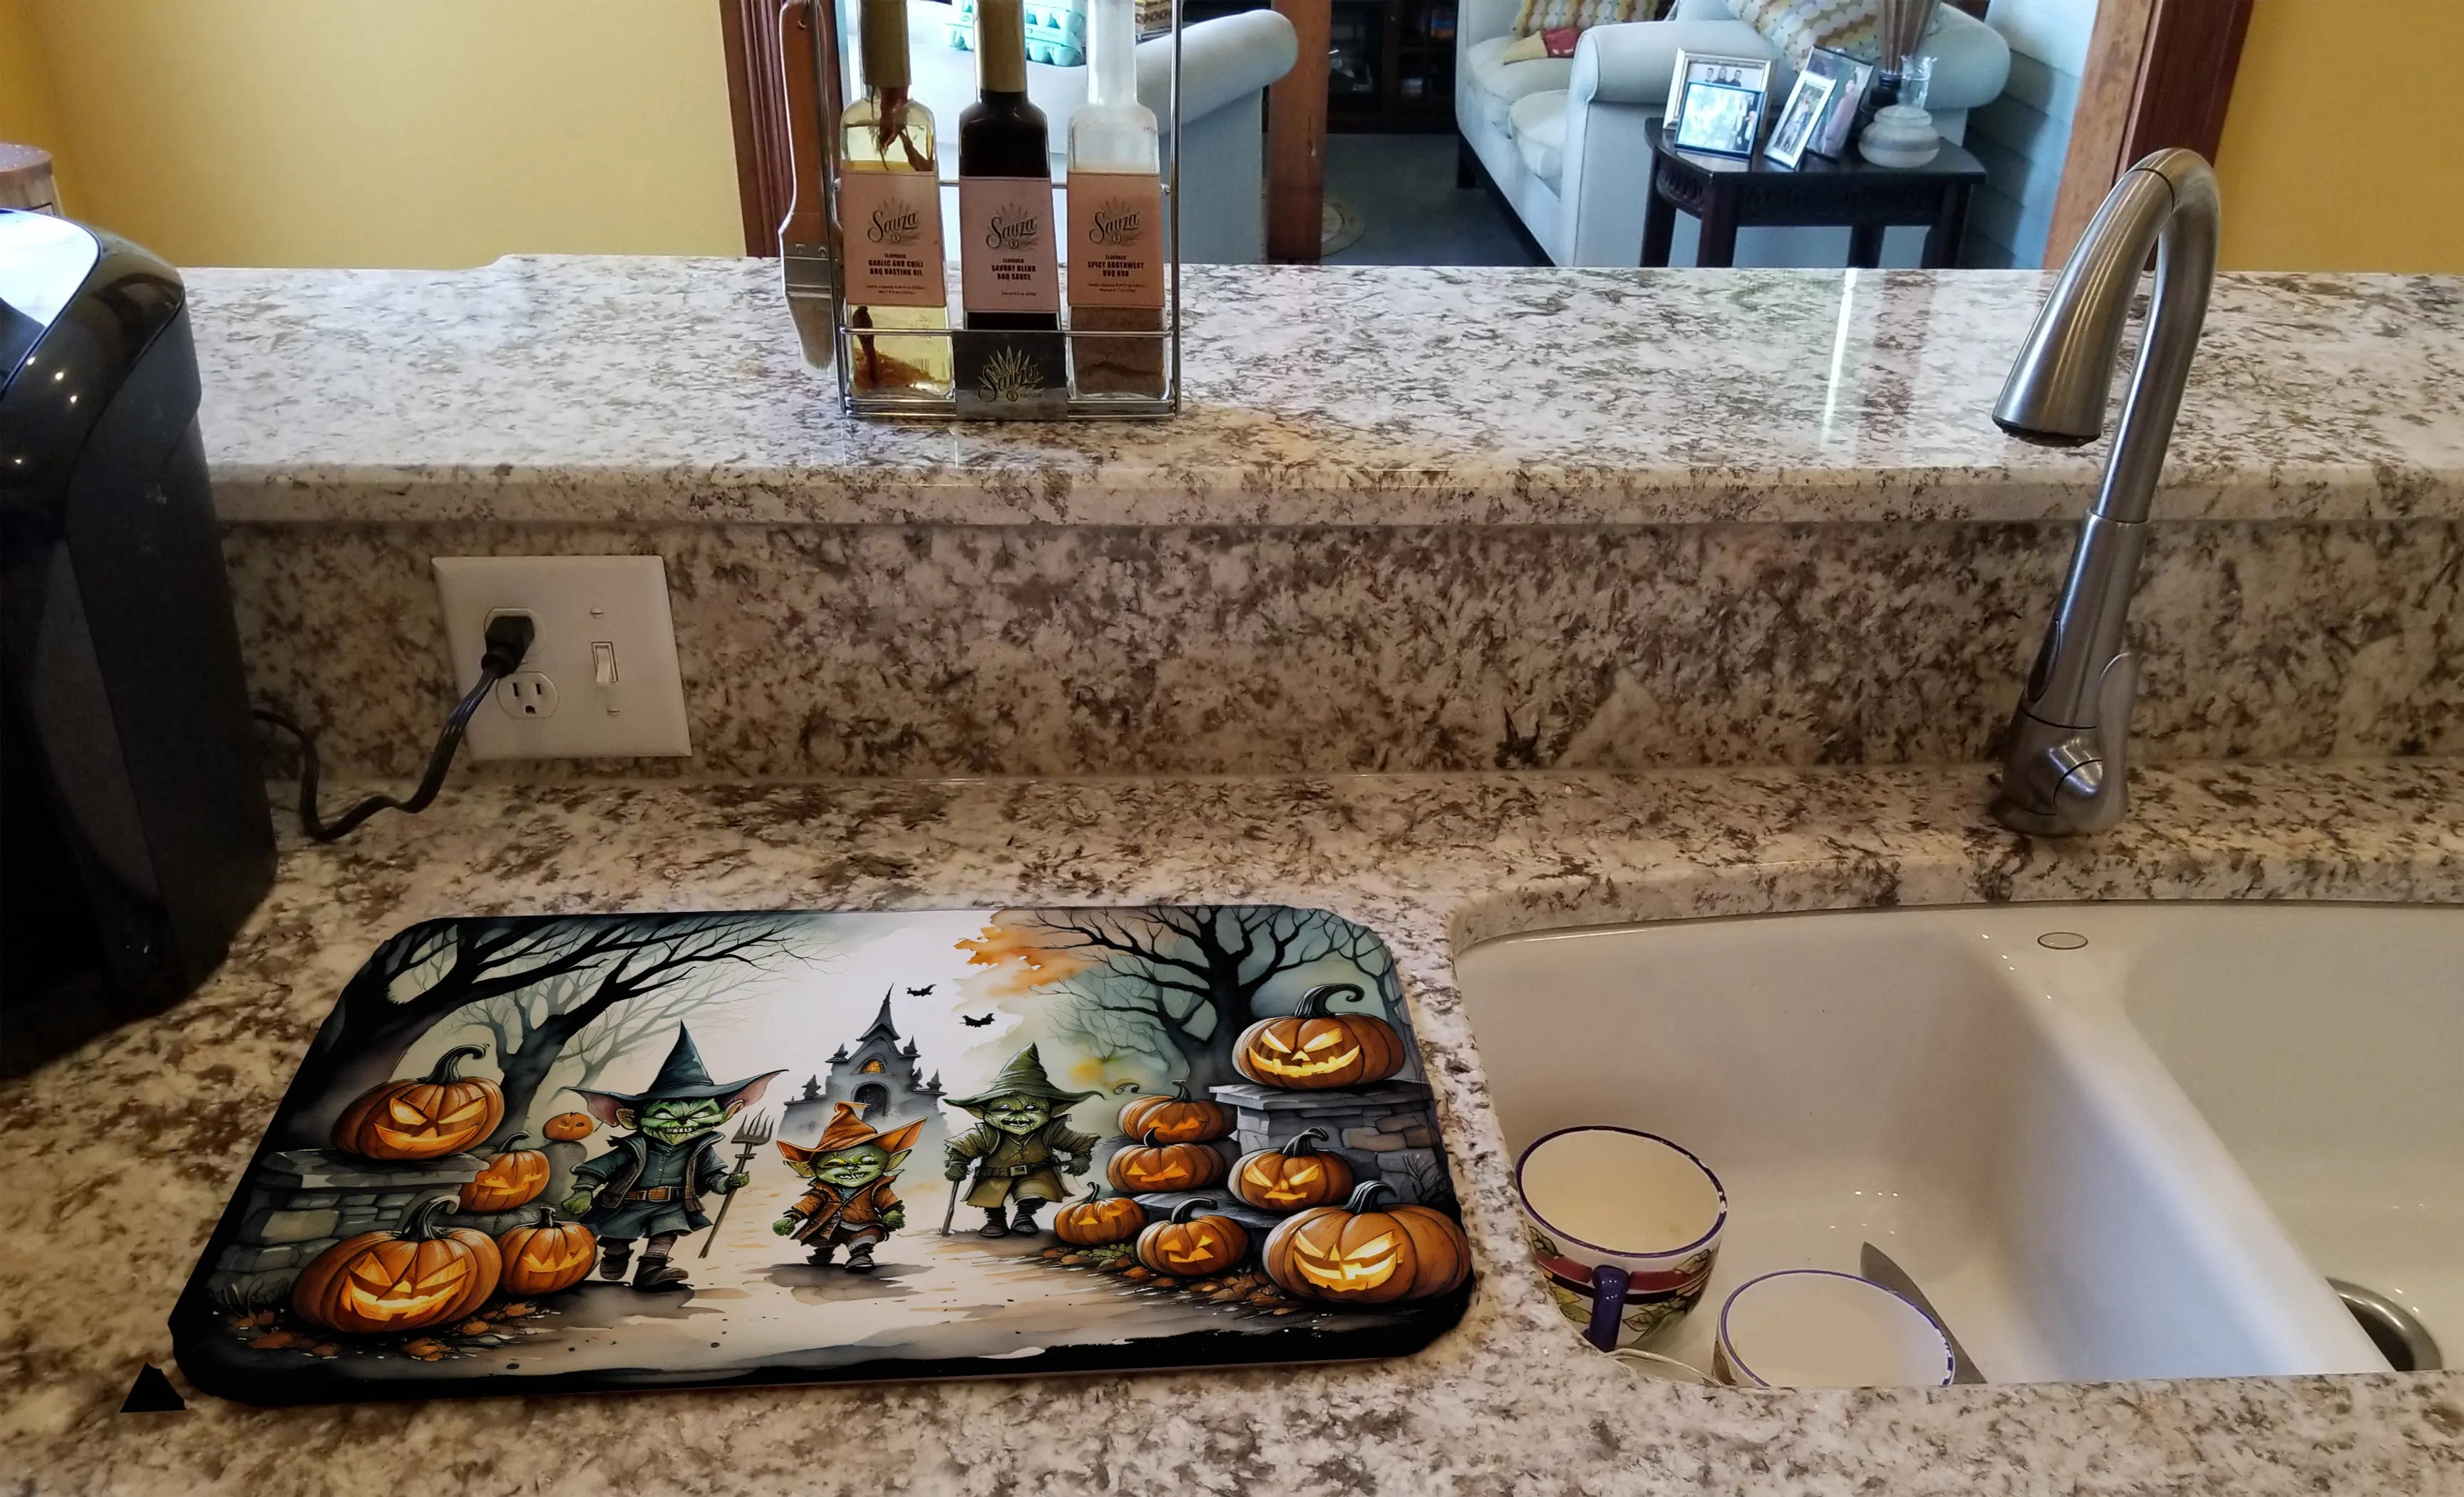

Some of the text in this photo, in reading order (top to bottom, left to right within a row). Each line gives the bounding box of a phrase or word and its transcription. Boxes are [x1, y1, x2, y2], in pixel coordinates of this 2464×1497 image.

[867, 210, 919, 243] Sauza
[986, 216, 1037, 249] Sauza
[1089, 211, 1140, 244] Sauza
[978, 364, 1042, 403] Sauza
